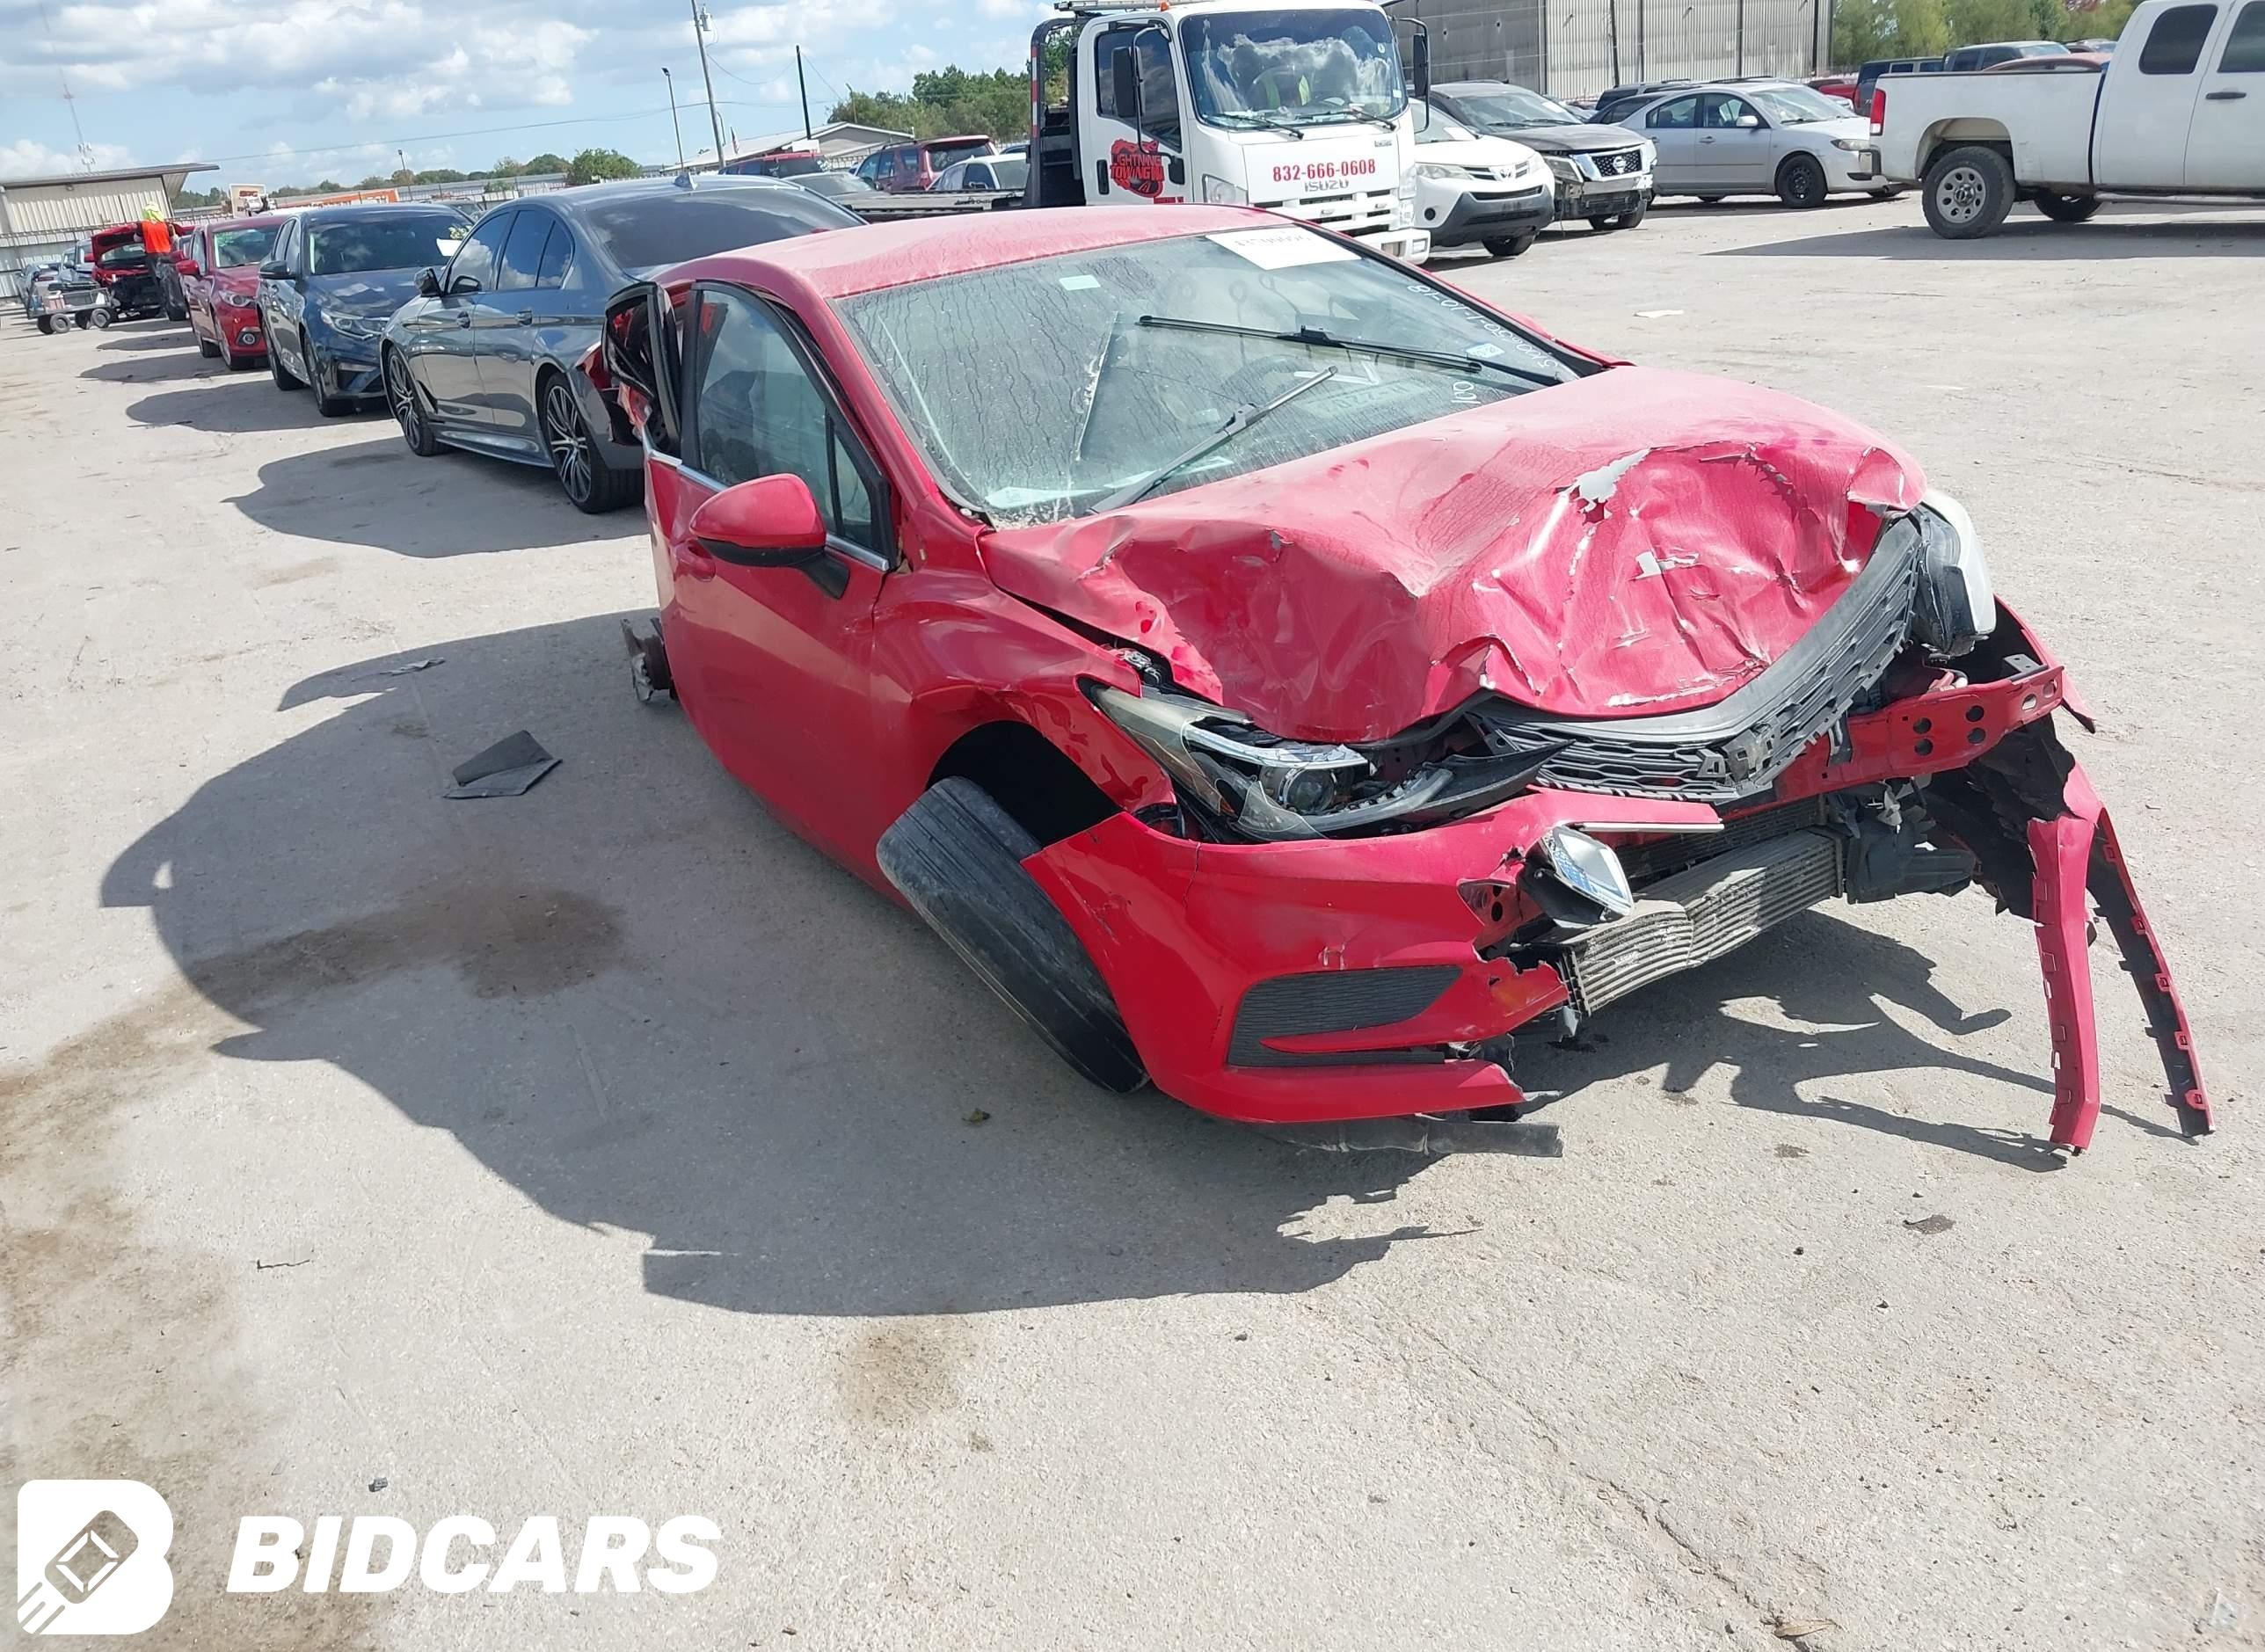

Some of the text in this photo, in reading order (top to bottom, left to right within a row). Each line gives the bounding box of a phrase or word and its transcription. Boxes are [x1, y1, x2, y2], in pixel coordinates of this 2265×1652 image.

[1111, 154, 1162, 167] LIGHTNING
[1273, 158, 1376, 182] 832-666-0608
[1305, 178, 1349, 193] ISUZU
